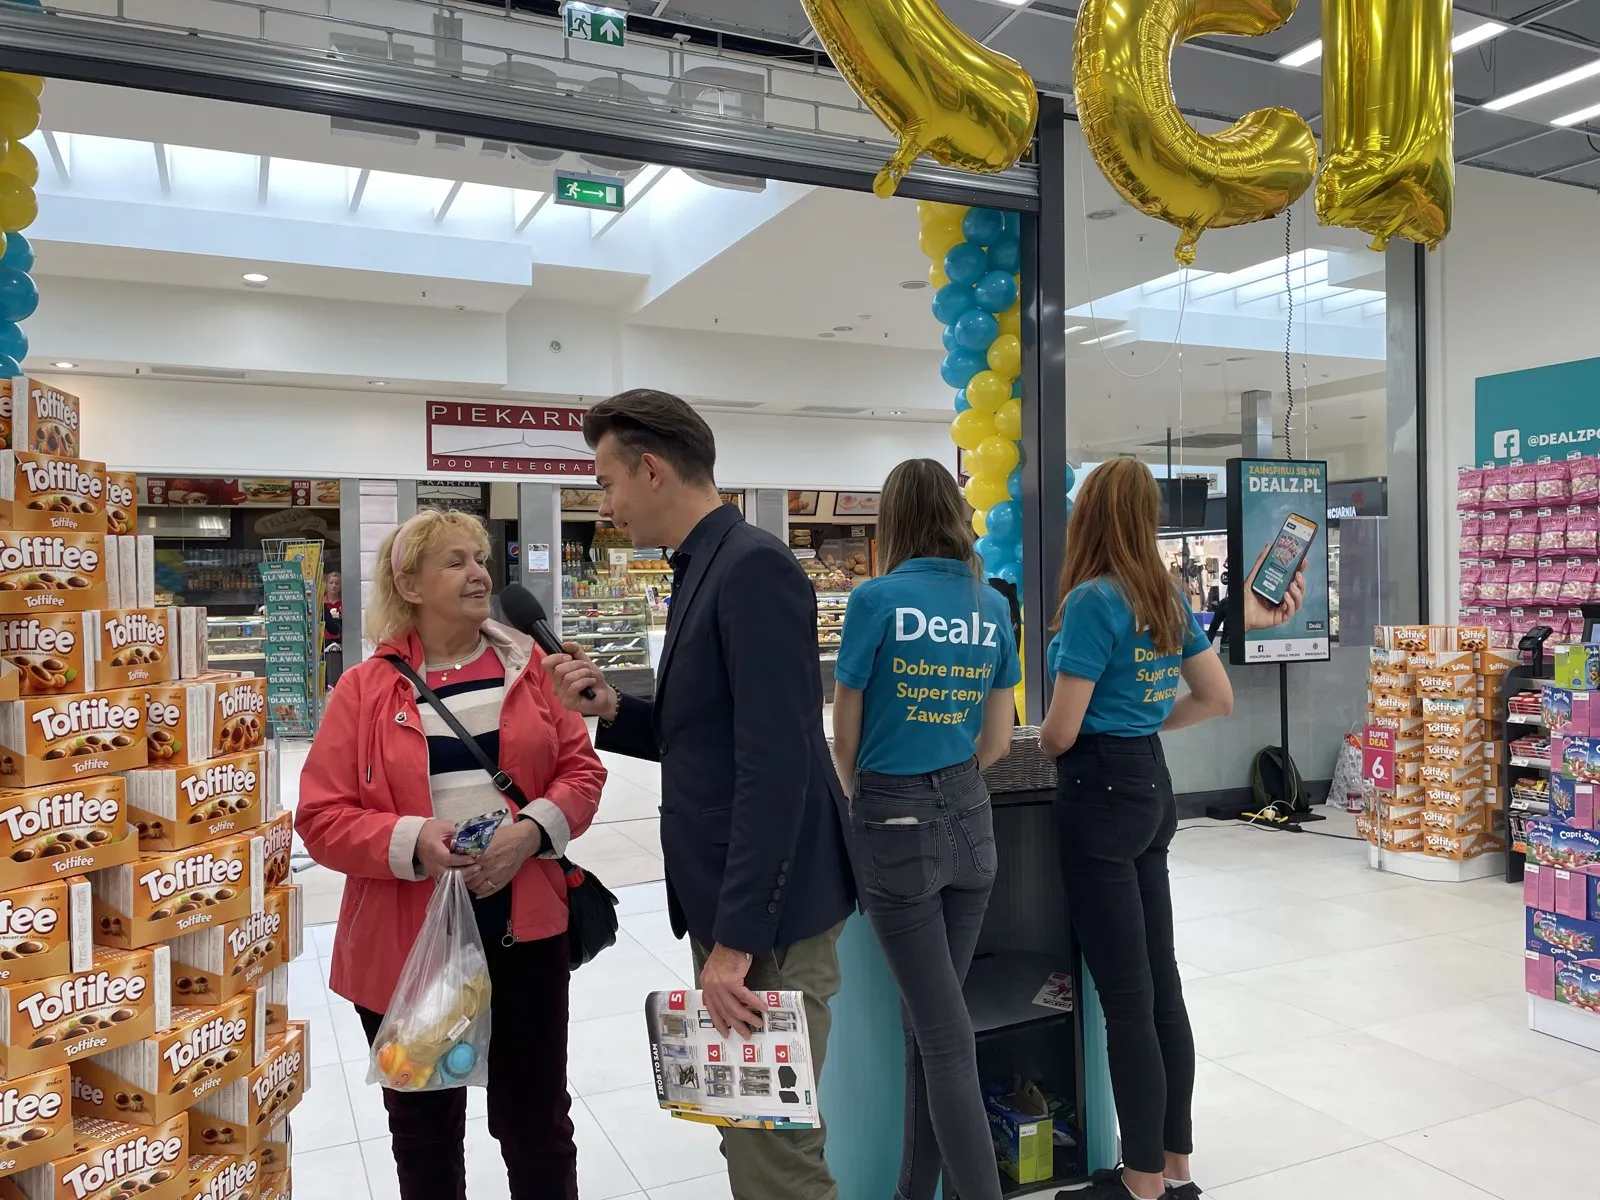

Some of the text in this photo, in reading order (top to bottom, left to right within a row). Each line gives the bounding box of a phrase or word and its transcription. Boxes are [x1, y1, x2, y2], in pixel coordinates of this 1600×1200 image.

[32, 389, 78, 430] Toffifee
[432, 405, 584, 426] PIEKARN
[432, 459, 594, 471] POD TELEGRAF
[1249, 465, 1295, 475] ZAINSPIRUJ
[1308, 468, 1320, 476] NA
[22, 461, 103, 499] Toffifee
[1249, 477, 1322, 493] DEALZ.PL
[50, 517, 78, 529] Toffifee
[24, 595, 65, 607] Toffifee
[105, 614, 165, 649] Toffifee
[895, 607, 997, 648] Dealz
[1395, 630, 1427, 640] Toffifee
[1459, 630, 1486, 640] Toffifee
[0, 620, 75, 653] ffifee
[893, 658, 992, 680] Dobre marki
[1167, 666, 1180, 677] ce
[1419, 677, 1452, 687] Toffifee
[219, 685, 264, 719] Toffifee
[896, 682, 984, 706] Super ceny
[1143, 687, 1177, 703] Zawsze
[32, 697, 140, 741] Toffifee
[905, 706, 970, 726] Zawsze!
[1369, 731, 1389, 739] SUPER
[1426, 723, 1461, 734] Toffifee
[1369, 738, 1389, 748] DEAL
[1426, 745, 1460, 757] Toffifee
[72, 759, 109, 773] Toffifee
[1372, 756, 1385, 779] 6
[1421, 766, 1450, 778] Toffifee
[181, 763, 256, 807] Toffifee
[1427, 790, 1461, 802] Toffifee
[0, 791, 119, 841] Toffifee
[1422, 812, 1452, 825] Toffifee
[208, 820, 235, 835] Toffifee
[264, 823, 292, 860] offifee
[1425, 836, 1460, 849] Toffifee
[1560, 830, 1600, 846] Capri-Sun
[52, 856, 94, 873] Toffifee
[140, 853, 243, 902] Toffifee
[176, 913, 212, 930] Toffifee
[228, 910, 281, 959] Toffifee
[1551, 947, 1578, 960] Capri-Sun
[18, 972, 145, 1029] Toffifee
[671, 993, 682, 1003] 5
[769, 994, 778, 1006] 10
[64, 1037, 107, 1057] Toffifee
[163, 1016, 247, 1075] Toffifee
[744, 1047, 753, 1060] 10
[655, 1062, 661, 1073] TO
[252, 1051, 301, 1107] Toffifee
[192, 1077, 222, 1098] Toffifee
[63, 1136, 182, 1200] Toffifee
[193, 1160, 257, 1200] ffifee
